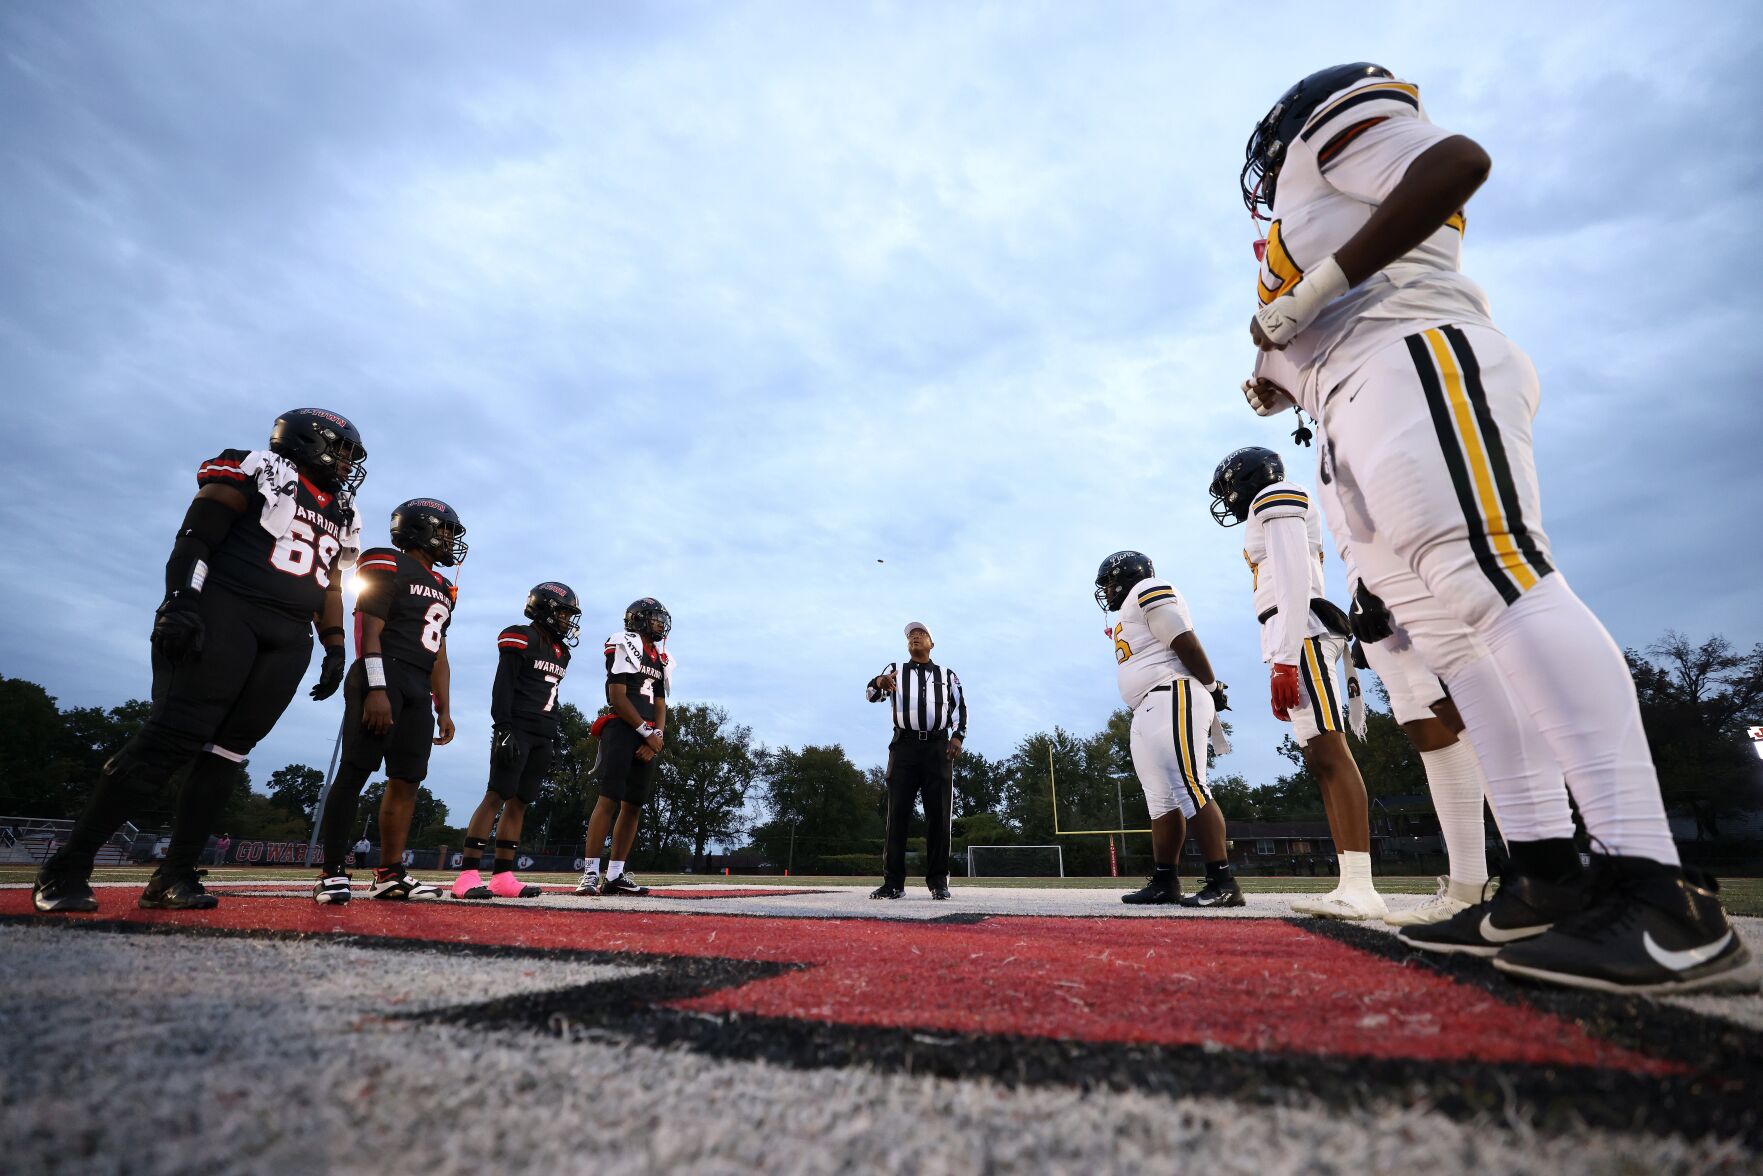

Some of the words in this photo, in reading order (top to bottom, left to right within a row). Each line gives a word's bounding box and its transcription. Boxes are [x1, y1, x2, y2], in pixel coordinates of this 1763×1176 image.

[296, 504, 340, 539] ARRIOR
[270, 517, 341, 589] 69
[1109, 551, 1135, 568] Lions
[420, 601, 450, 654] 8
[543, 674, 560, 712] 7
[639, 678, 655, 705] 4
[235, 841, 265, 865] GO
